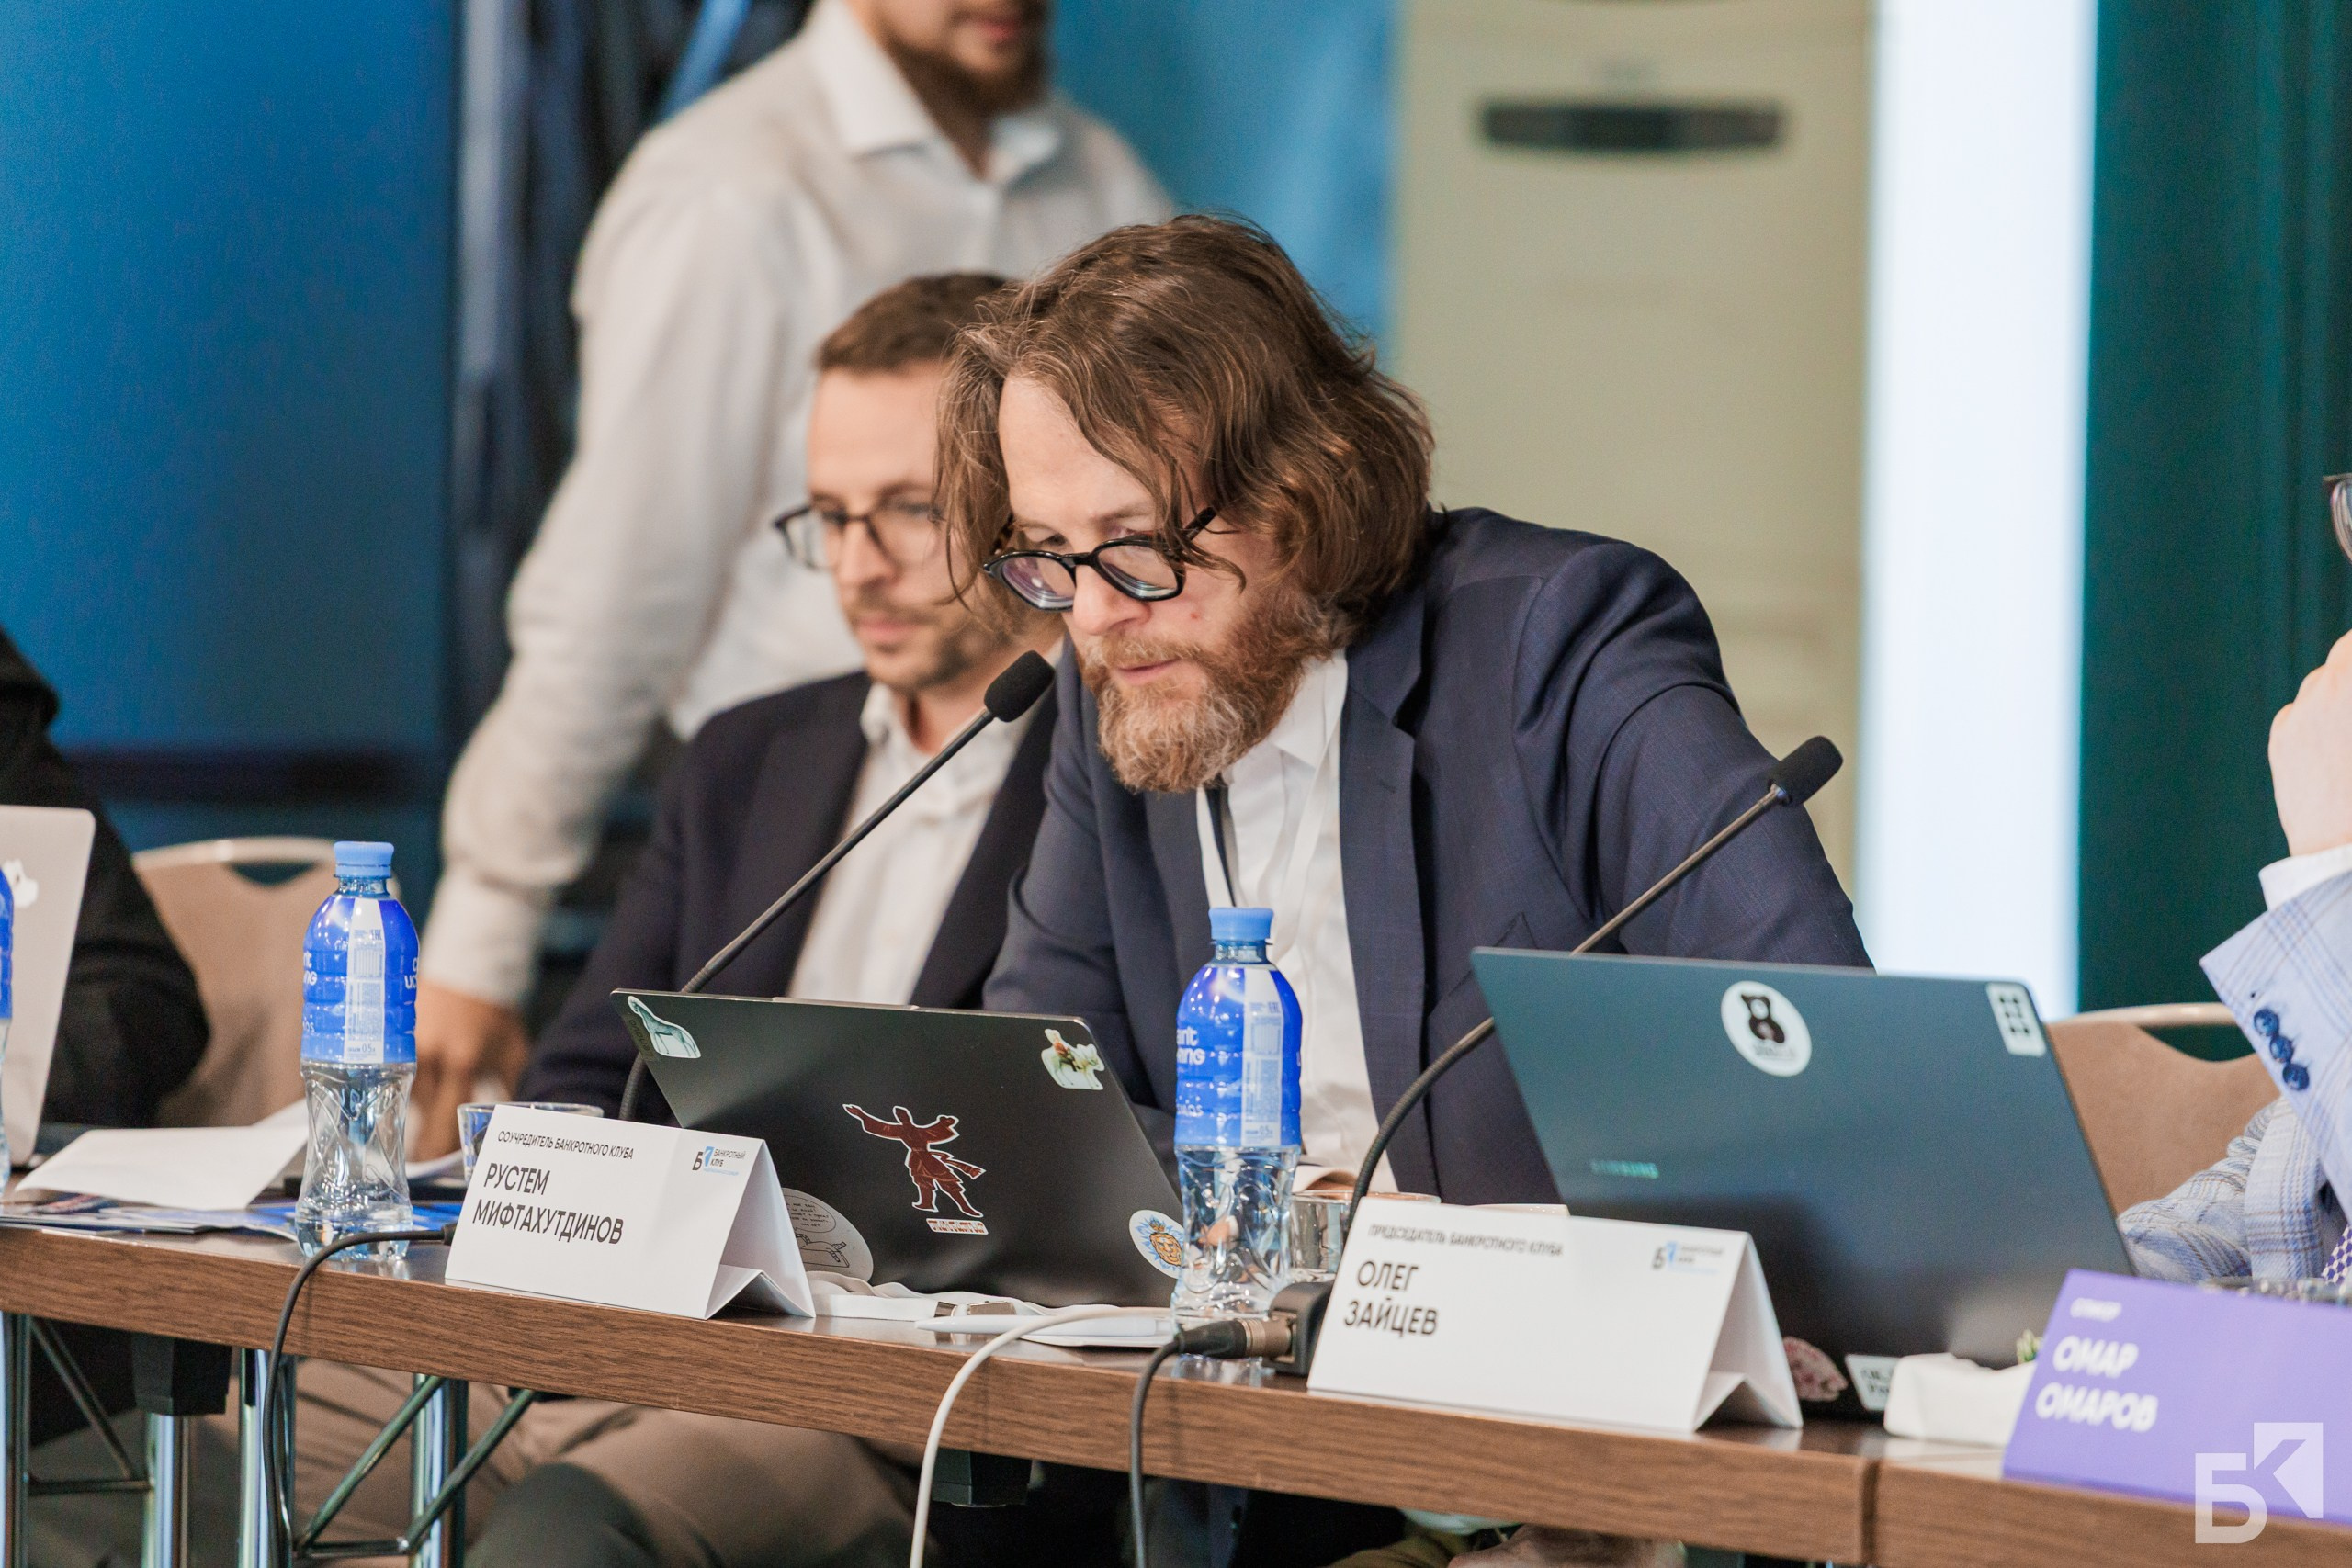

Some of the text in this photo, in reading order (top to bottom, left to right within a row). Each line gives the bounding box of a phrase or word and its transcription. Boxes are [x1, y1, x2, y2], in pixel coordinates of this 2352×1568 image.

[498, 1130, 634, 1159] СОУЧРЕДИТЕЛЬ БАНКРОТНОГО КЛУБА
[483, 1162, 551, 1195] РУСТЕМ
[472, 1199, 624, 1245] МИФТАХУТДИНОВ
[1369, 1224, 1564, 1257] ПРЕДСЕДАТЕЛЬ БАНКРОТНОГО КЛУБА
[1357, 1260, 1419, 1291] ОЛЕГ
[1344, 1296, 1438, 1338] ЗАЙЦЕВ
[2053, 1335, 2139, 1378] ОМАР
[2035, 1382, 2159, 1432] ОМАРОВ
